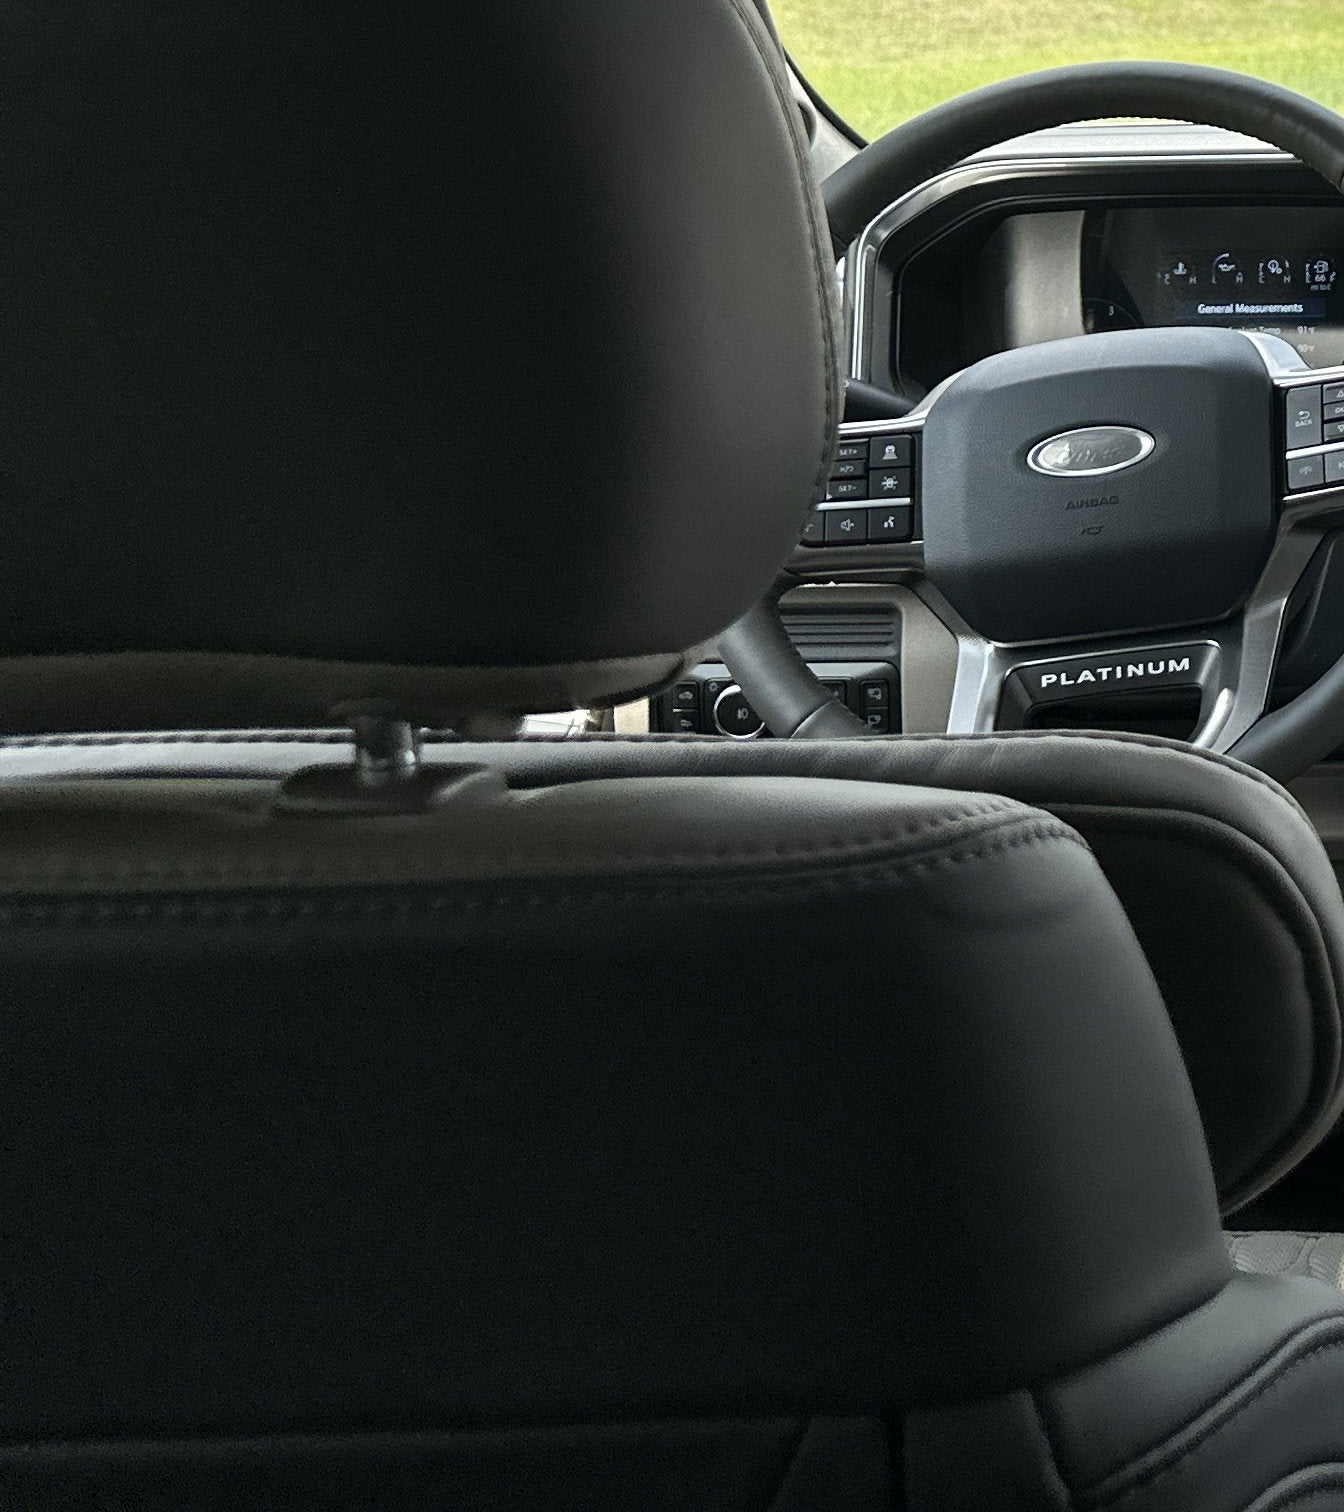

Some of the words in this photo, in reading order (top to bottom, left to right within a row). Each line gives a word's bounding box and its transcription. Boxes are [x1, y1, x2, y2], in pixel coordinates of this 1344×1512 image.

[1198, 303, 1233, 313] General
[1235, 303, 1303, 313] Measurements
[1066, 496, 1119, 510] AIRBAG
[1041, 657, 1190, 688] PLATINUM
